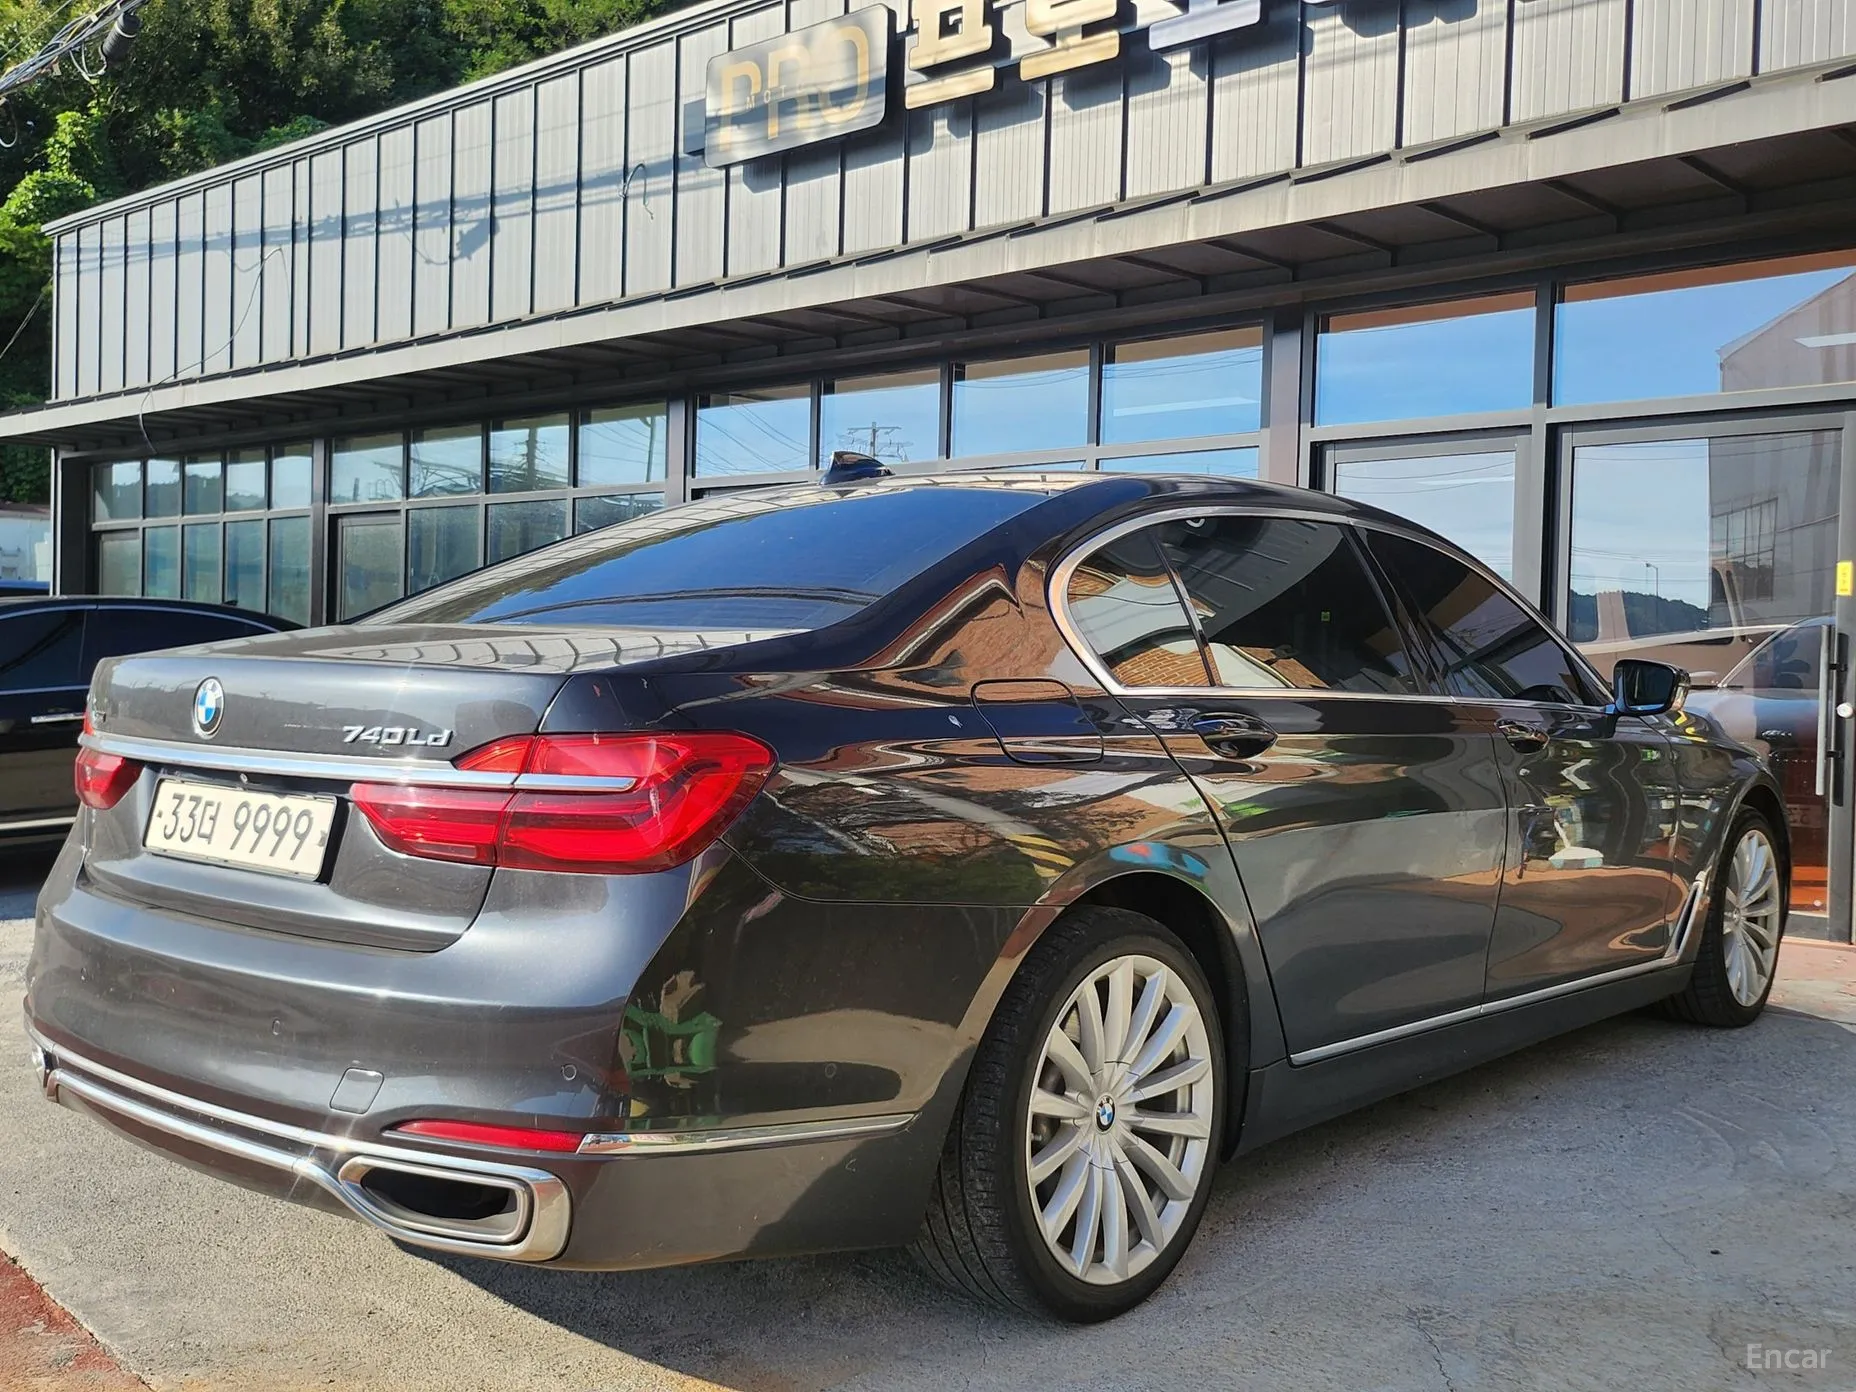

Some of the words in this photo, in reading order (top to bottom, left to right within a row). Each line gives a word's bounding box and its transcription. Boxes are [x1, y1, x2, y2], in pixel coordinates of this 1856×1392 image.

[719, 25, 869, 151] PRO
[342, 725, 453, 748] 740Ld
[163, 793, 221, 845] 33더
[230, 800, 313, 861] 9999
